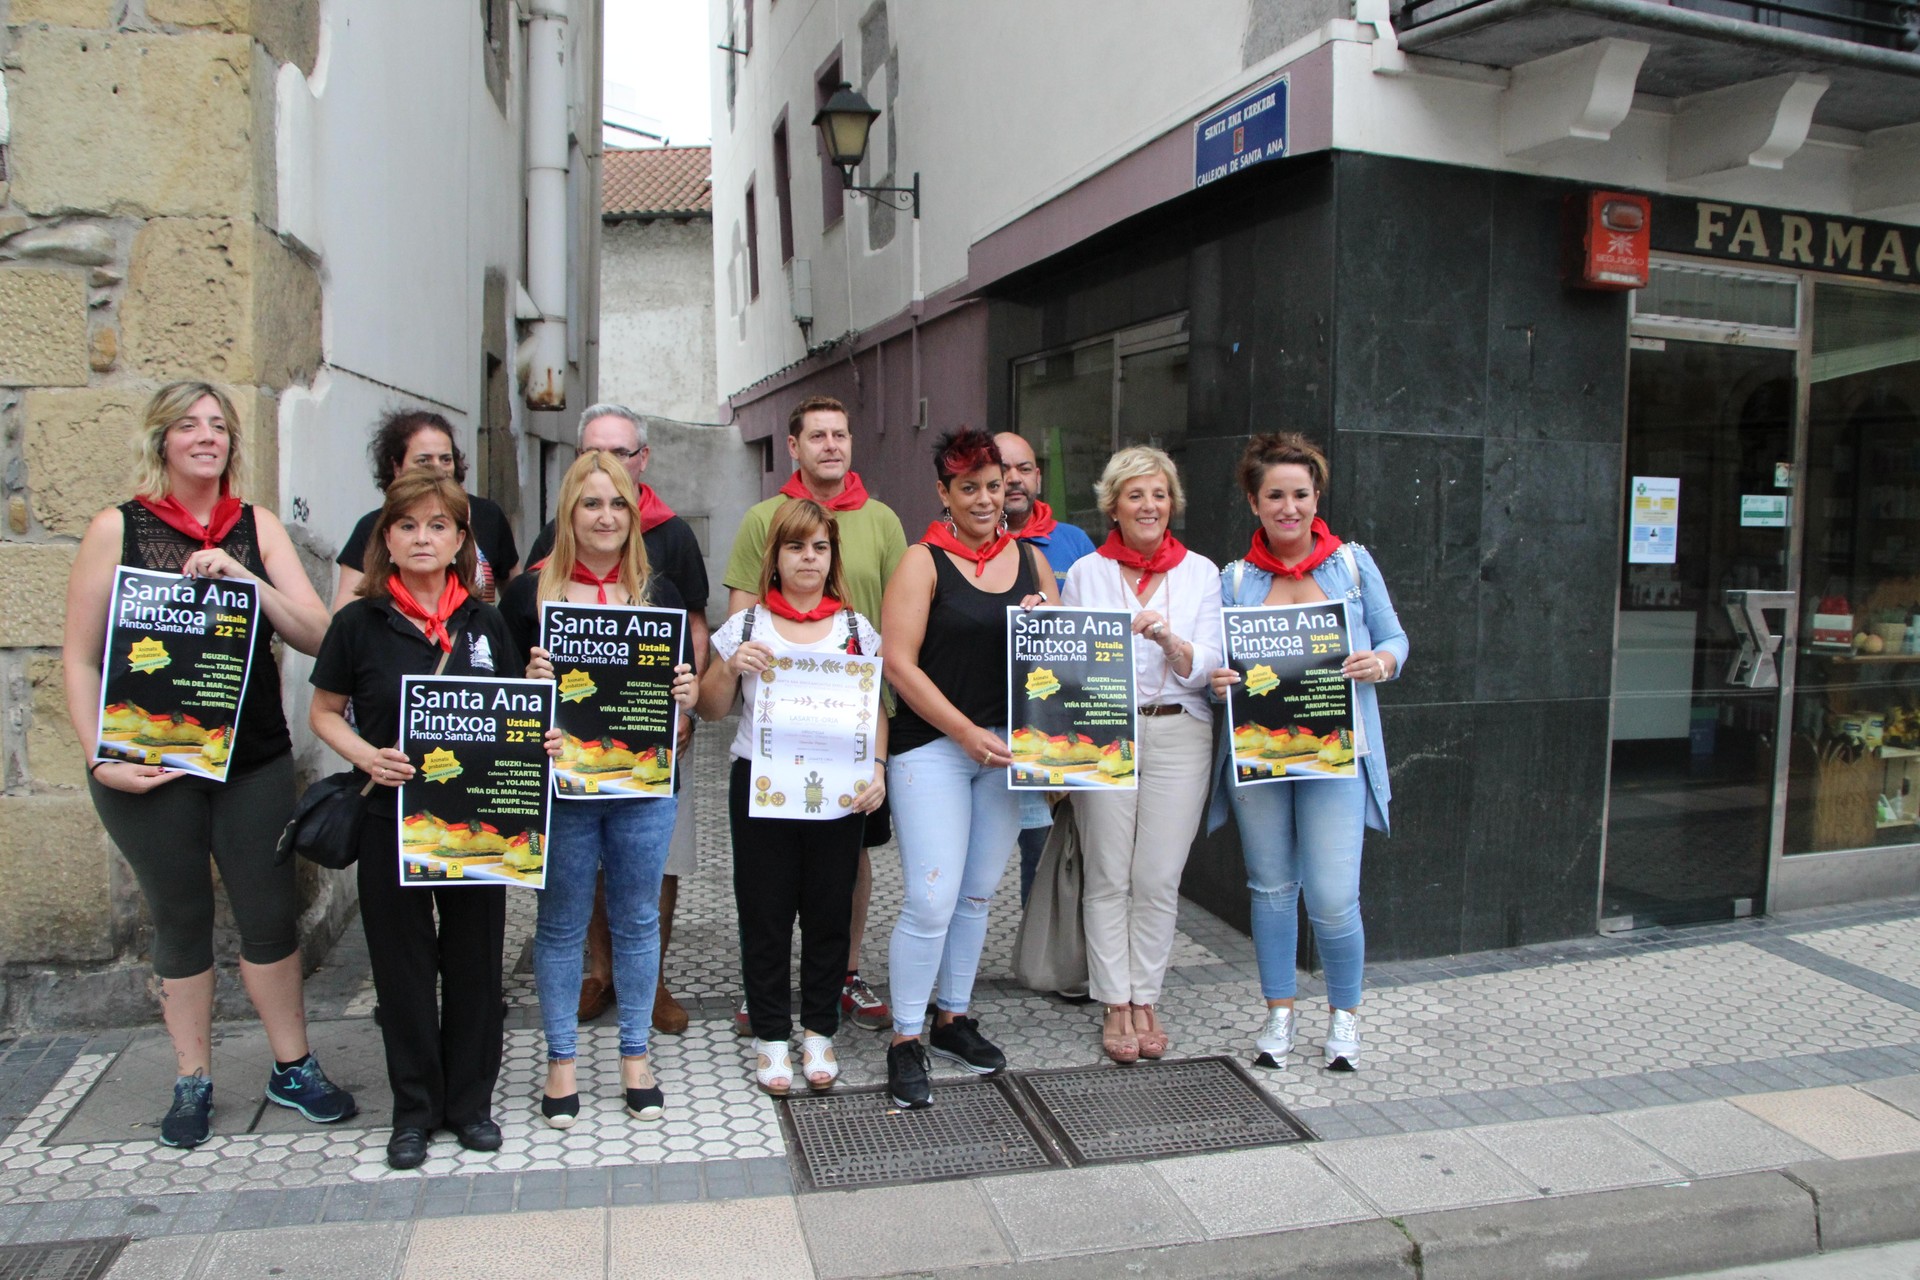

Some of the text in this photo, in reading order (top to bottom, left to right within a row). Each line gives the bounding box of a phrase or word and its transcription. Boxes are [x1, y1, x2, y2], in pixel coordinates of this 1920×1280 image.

[1205, 92, 1275, 140] SANTA ANA KARKABA
[1197, 138, 1283, 186] CALLEJON DE SANTA ANA
[123, 577, 248, 609] Santa Ana
[121, 600, 206, 626] Pintxoa
[216, 613, 247, 624] Uztaila
[119, 618, 204, 635] Pintxo Santa Ana
[550, 611, 671, 637] Santa Ana
[1016, 614, 1123, 636] Santa Ana
[1229, 611, 1338, 634] Santa Ana
[214, 625, 233, 637] 22
[1310, 633, 1339, 641] Uztaila
[550, 635, 628, 656] Pintxoa
[639, 643, 670, 652] Uztaila
[1016, 635, 1087, 653] Pintxoa
[1232, 635, 1303, 652] Pintxoa
[1312, 644, 1327, 654] 22
[202, 653, 229, 661] EGUZKI
[549, 653, 628, 665] Pintxo Santa Ana
[1016, 652, 1087, 661] Pintxo Santa Ana
[1095, 652, 1110, 661] 22
[1232, 648, 1304, 660] Pintxo Santa Ana
[638, 655, 654, 666] 22
[173, 679, 191, 687] VIÑA
[207, 681, 222, 689] MAR
[196, 690, 225, 698] ARKUPE
[411, 685, 483, 710] Santa
[492, 688, 542, 712] Ana
[410, 710, 496, 732] Pintxoa
[506, 718, 540, 727] Uztaila
[410, 730, 495, 742] Pintxo Santa Ana
[506, 731, 524, 742] 22
